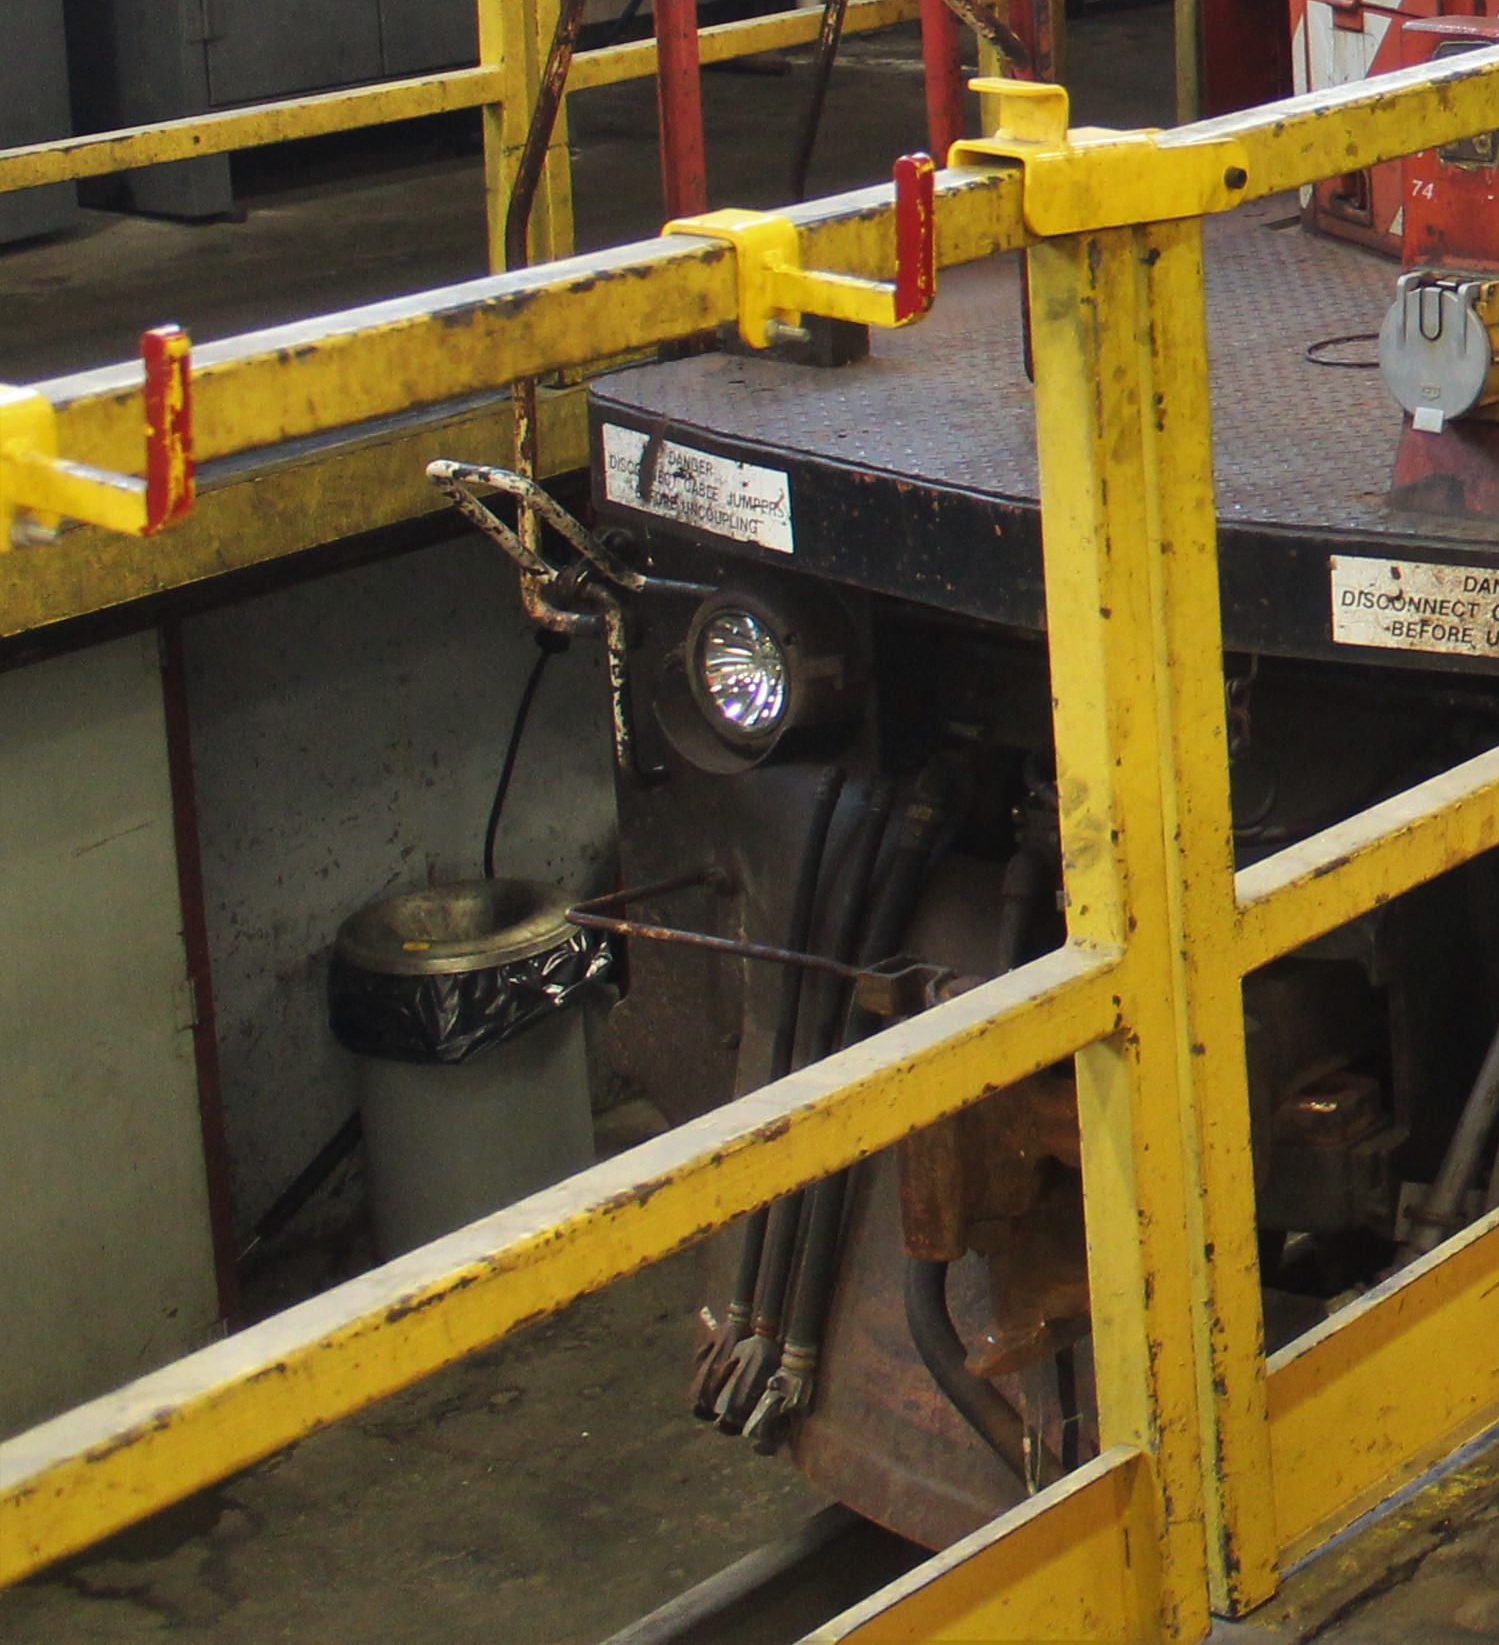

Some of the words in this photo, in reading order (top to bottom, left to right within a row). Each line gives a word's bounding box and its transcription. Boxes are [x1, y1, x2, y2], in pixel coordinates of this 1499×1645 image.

[1411, 179, 1435, 200] 74
[667, 450, 713, 475] DANGER
[684, 477, 719, 501] CABLE
[727, 490, 785, 519] JUMPERS
[680, 501, 759, 535] UNCOUPLING
[1342, 589, 1480, 620] DISCONNECT
[1391, 620, 1474, 645] BEFORE
